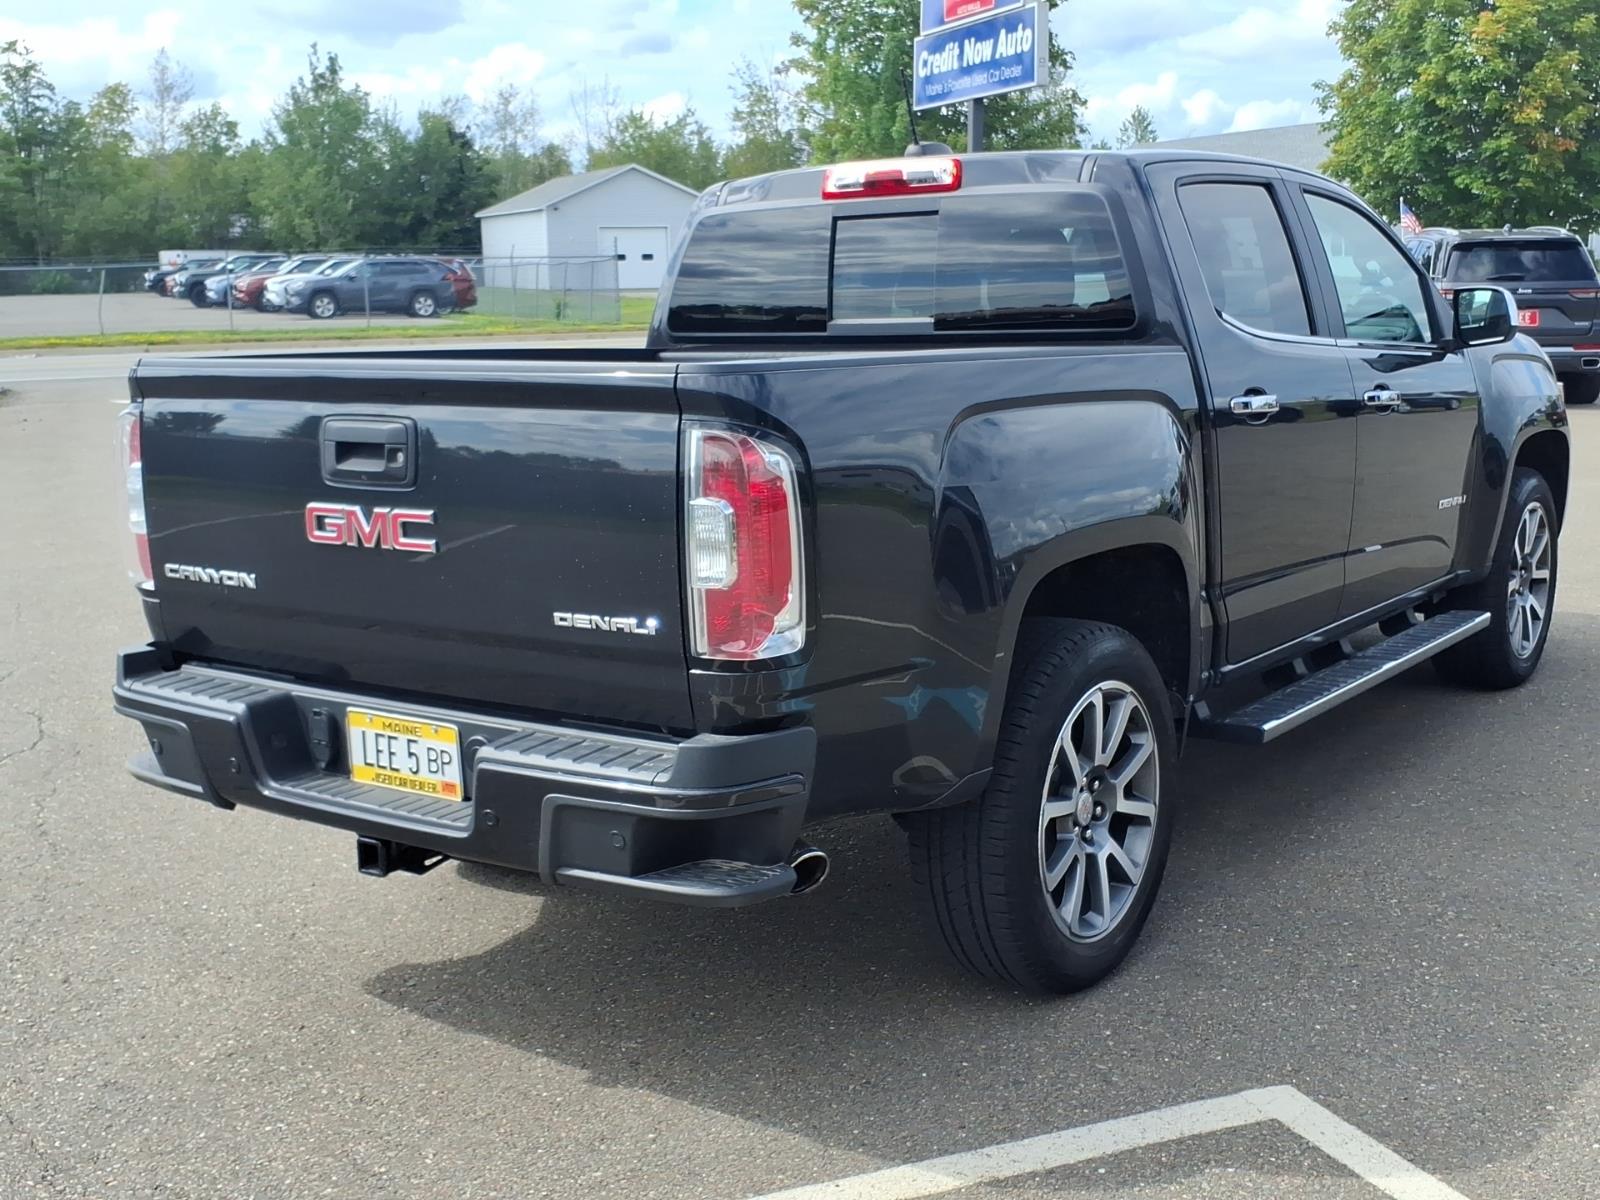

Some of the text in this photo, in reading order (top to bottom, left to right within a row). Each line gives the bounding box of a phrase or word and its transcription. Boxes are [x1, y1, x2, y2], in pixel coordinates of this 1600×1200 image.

[919, 23, 1033, 78] Credit Now Auto
[989, 69, 1000, 83] Car
[1000, 64, 1022, 80] Dealer
[1519, 311, 1532, 324] EE
[305, 501, 436, 553] GMC
[164, 563, 257, 589] CANYON
[553, 611, 657, 635] DENALI
[382, 721, 422, 737] MAINE
[361, 730, 452, 777] LEE 5 BP
[394, 776, 408, 787] CAR
